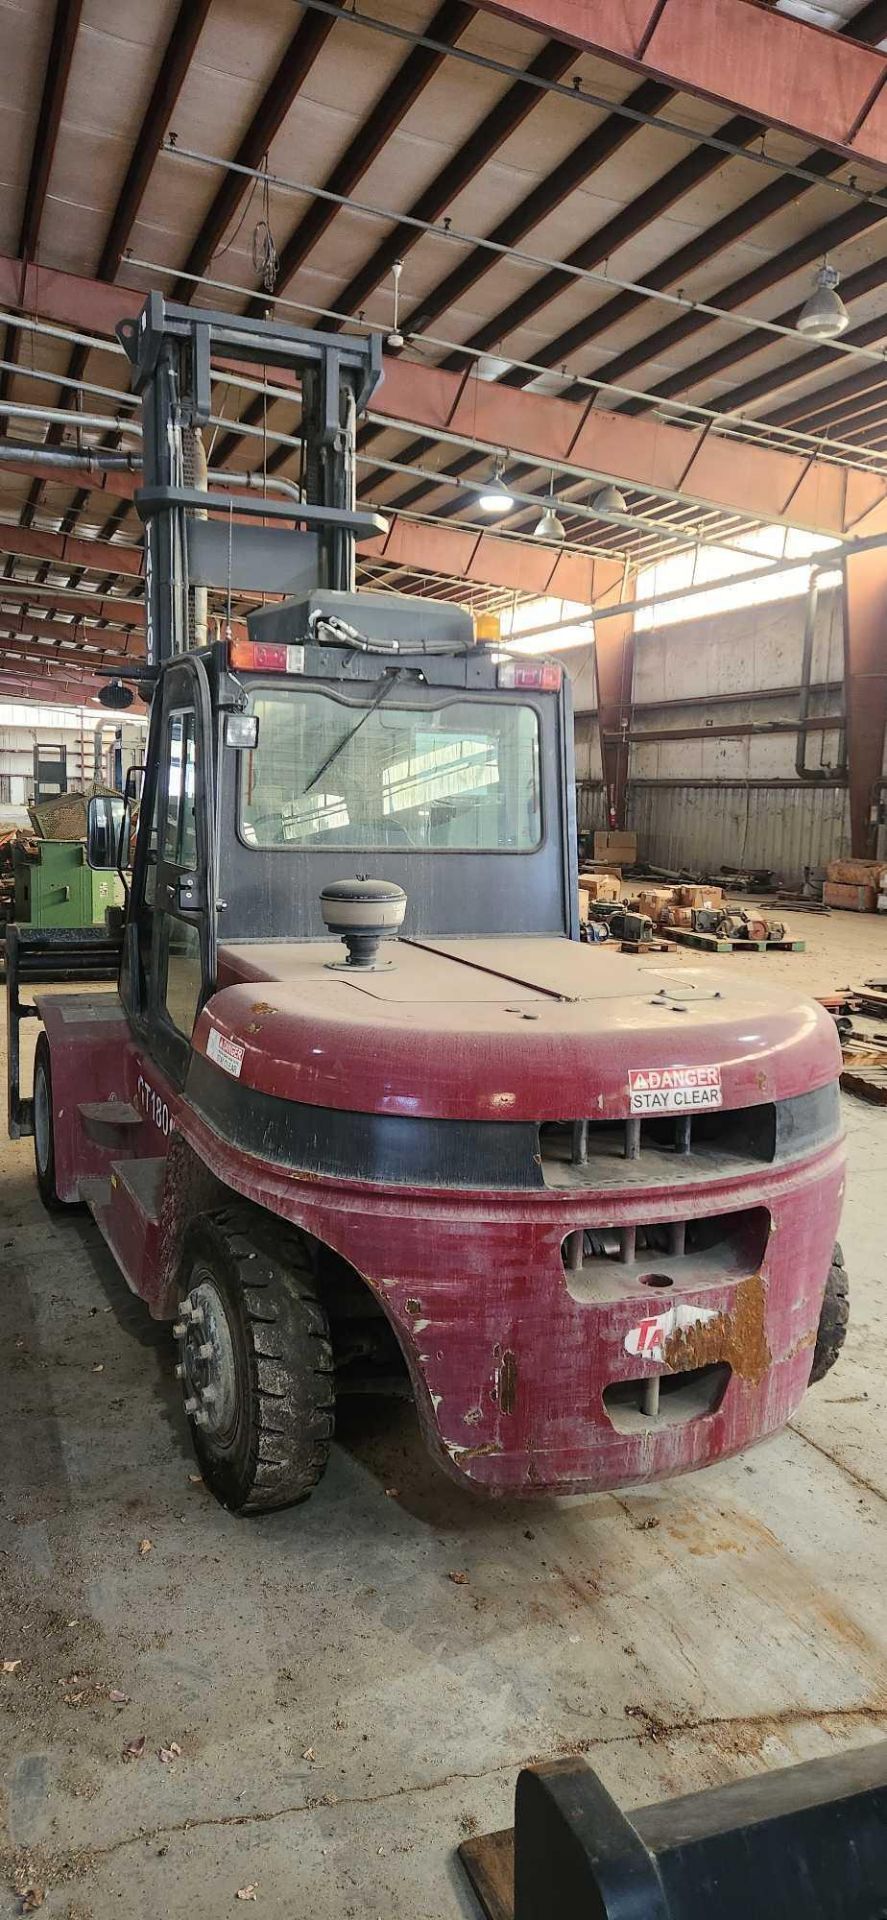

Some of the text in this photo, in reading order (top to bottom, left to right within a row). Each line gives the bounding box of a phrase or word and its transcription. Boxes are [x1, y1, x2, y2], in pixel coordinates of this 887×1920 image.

[648, 1067, 718, 1088] DANGER
[633, 1089, 718, 1108] STAY CLEAR
